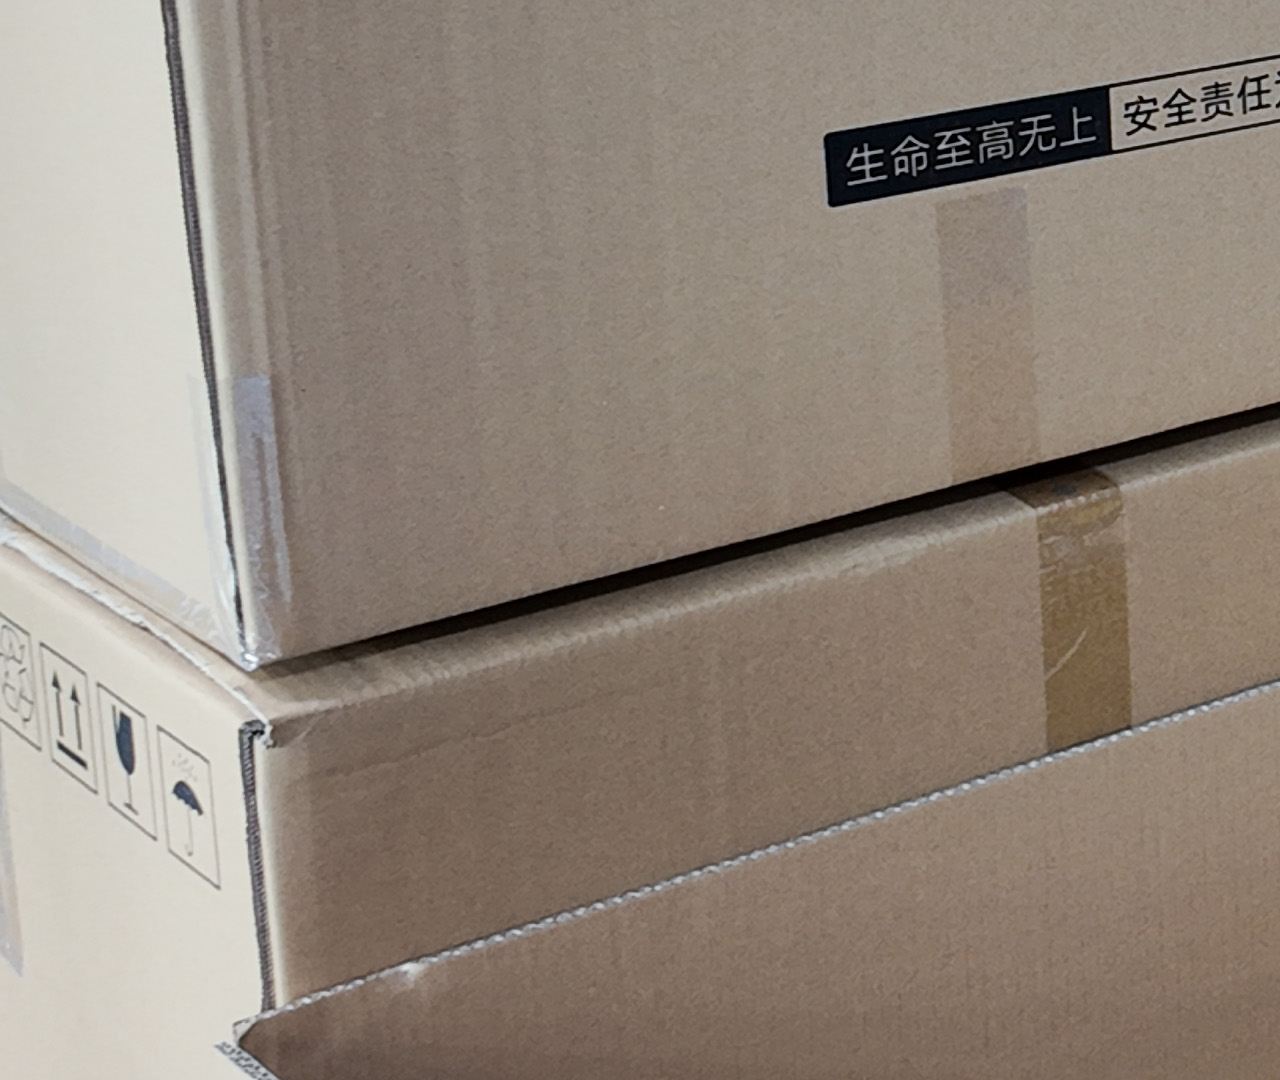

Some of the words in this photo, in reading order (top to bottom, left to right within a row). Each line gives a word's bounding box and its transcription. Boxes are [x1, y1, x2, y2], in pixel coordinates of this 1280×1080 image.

[845, 106, 1098, 187] 生命至高无上
